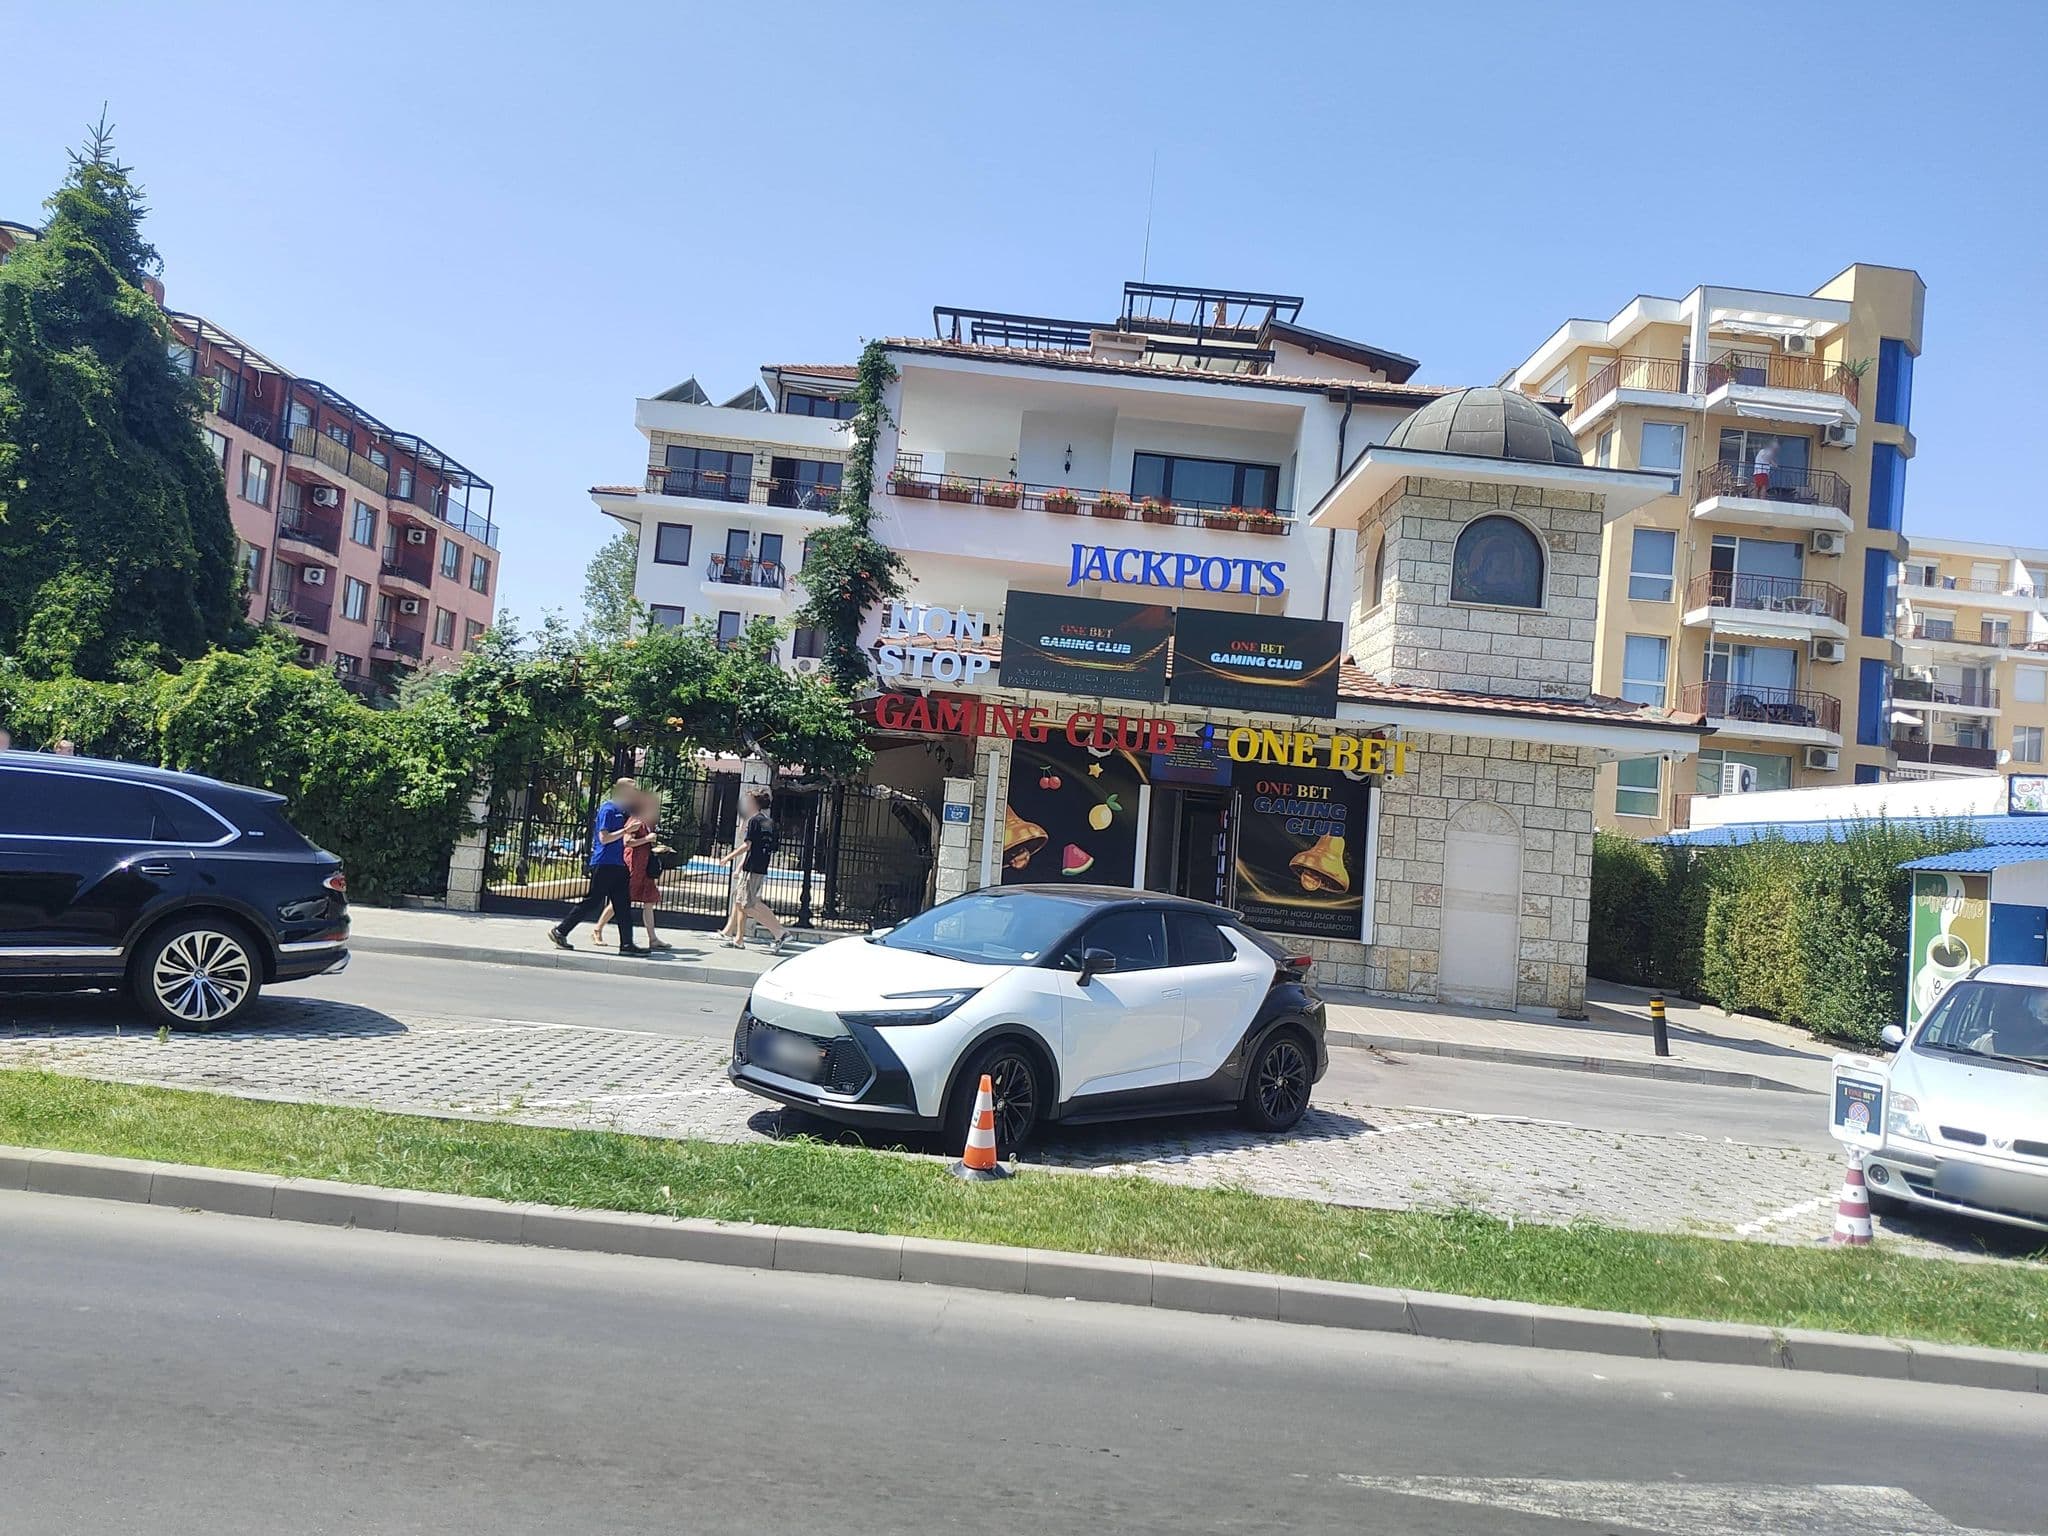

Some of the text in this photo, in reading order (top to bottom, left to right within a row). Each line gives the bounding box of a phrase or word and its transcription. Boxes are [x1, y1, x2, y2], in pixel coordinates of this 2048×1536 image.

[1067, 543, 1286, 597] JACKPOTS
[889, 599, 984, 643] NON
[1061, 624, 1115, 639] ONE BET
[1040, 635, 1132, 655] GAMING CLUB
[1231, 640, 1285, 655] ONE BET
[877, 645, 991, 684] STOP
[1210, 652, 1304, 671] GAMING CLUB
[875, 693, 1176, 755] GAMING CLUB
[1228, 727, 1318, 768] ONE
[1328, 735, 1416, 776] BET
[1255, 780, 1332, 800] ONE BET
[1253, 796, 1348, 821] GAMING
[1285, 818, 1346, 838] CLUB
[1313, 911, 1336, 922] риск
